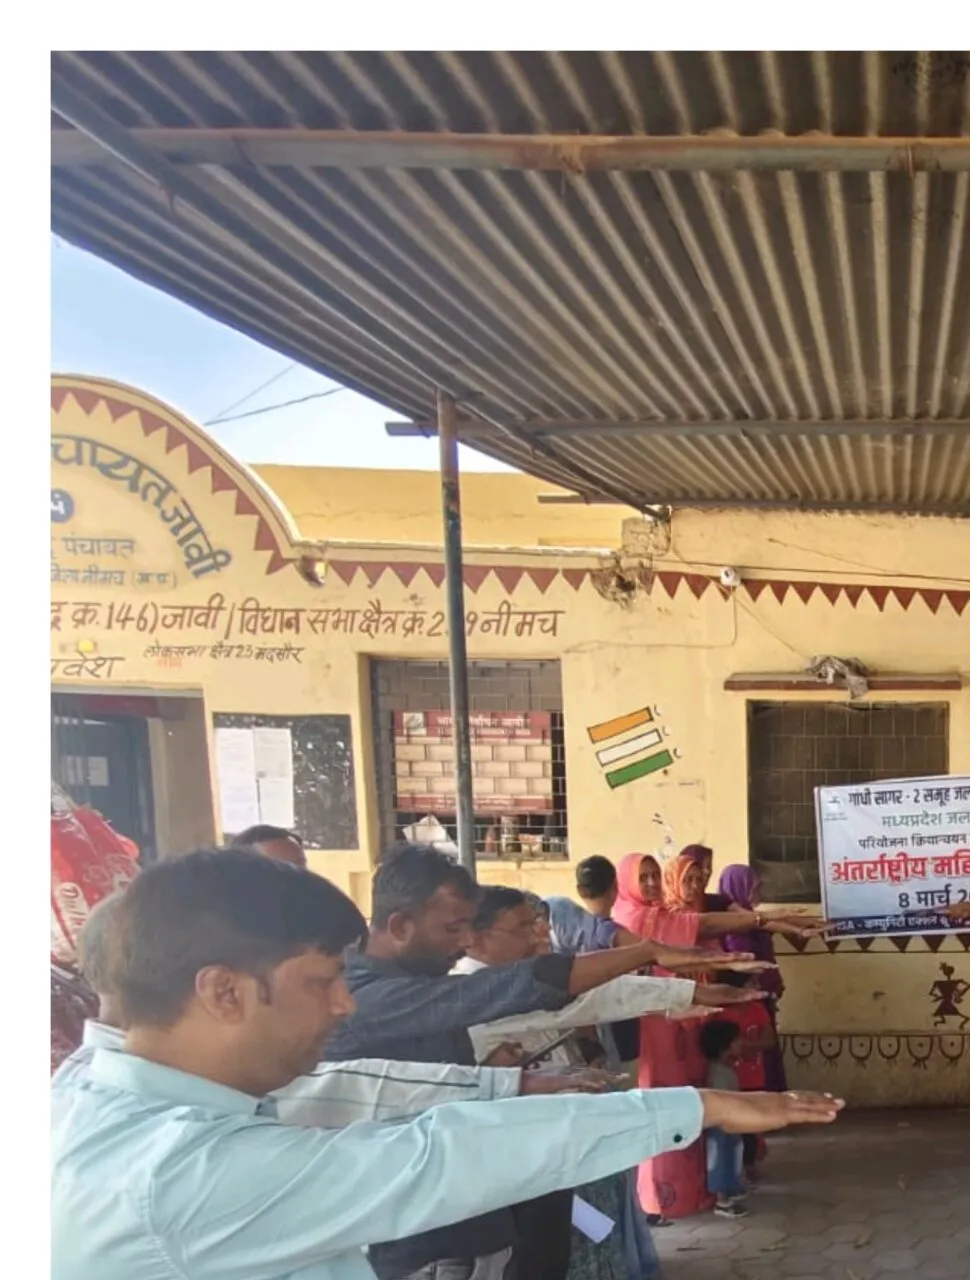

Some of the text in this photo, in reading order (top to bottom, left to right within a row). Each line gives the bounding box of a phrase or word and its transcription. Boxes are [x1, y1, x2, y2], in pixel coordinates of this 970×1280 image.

[51, 434, 178, 507] चायत
[427, 610, 478, 637] 29
[480, 600, 565, 637] नीमच
[848, 787, 872, 806] गांधी
[873, 790, 903, 804] सागर
[913, 788, 920, 803] 2
[923, 787, 950, 806] समूह
[881, 810, 942, 828] मध्यप्रदेश
[946, 811, 970, 825] जल
[858, 834, 908, 849] परियोजना
[898, 892, 910, 908] 8
[915, 883, 952, 907] मार्च
